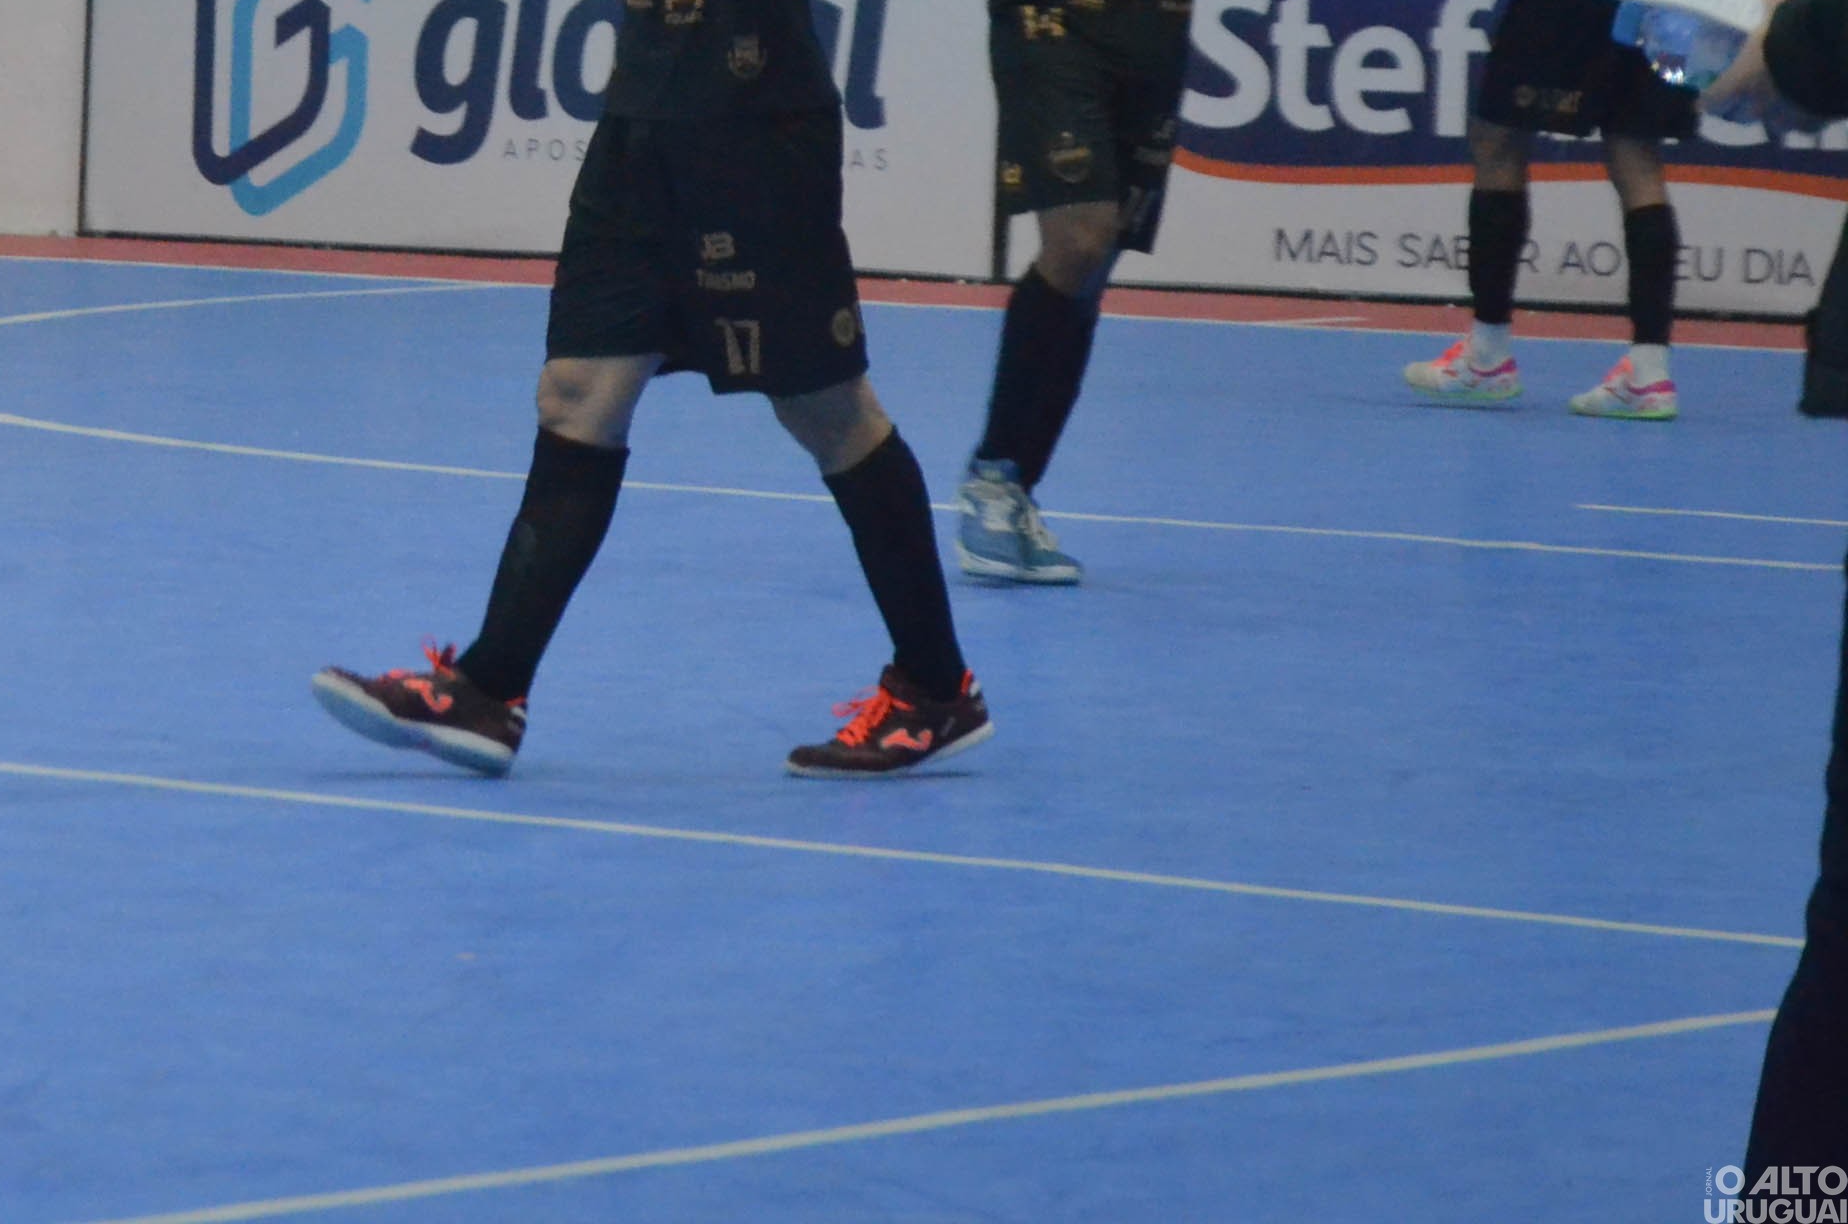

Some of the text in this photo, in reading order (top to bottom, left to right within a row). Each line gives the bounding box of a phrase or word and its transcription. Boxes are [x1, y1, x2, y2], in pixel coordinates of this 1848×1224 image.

[503, 136, 589, 163] APOS
[1274, 228, 1816, 287] MAIS SABR AO EU DIA
[714, 316, 761, 375] 17
